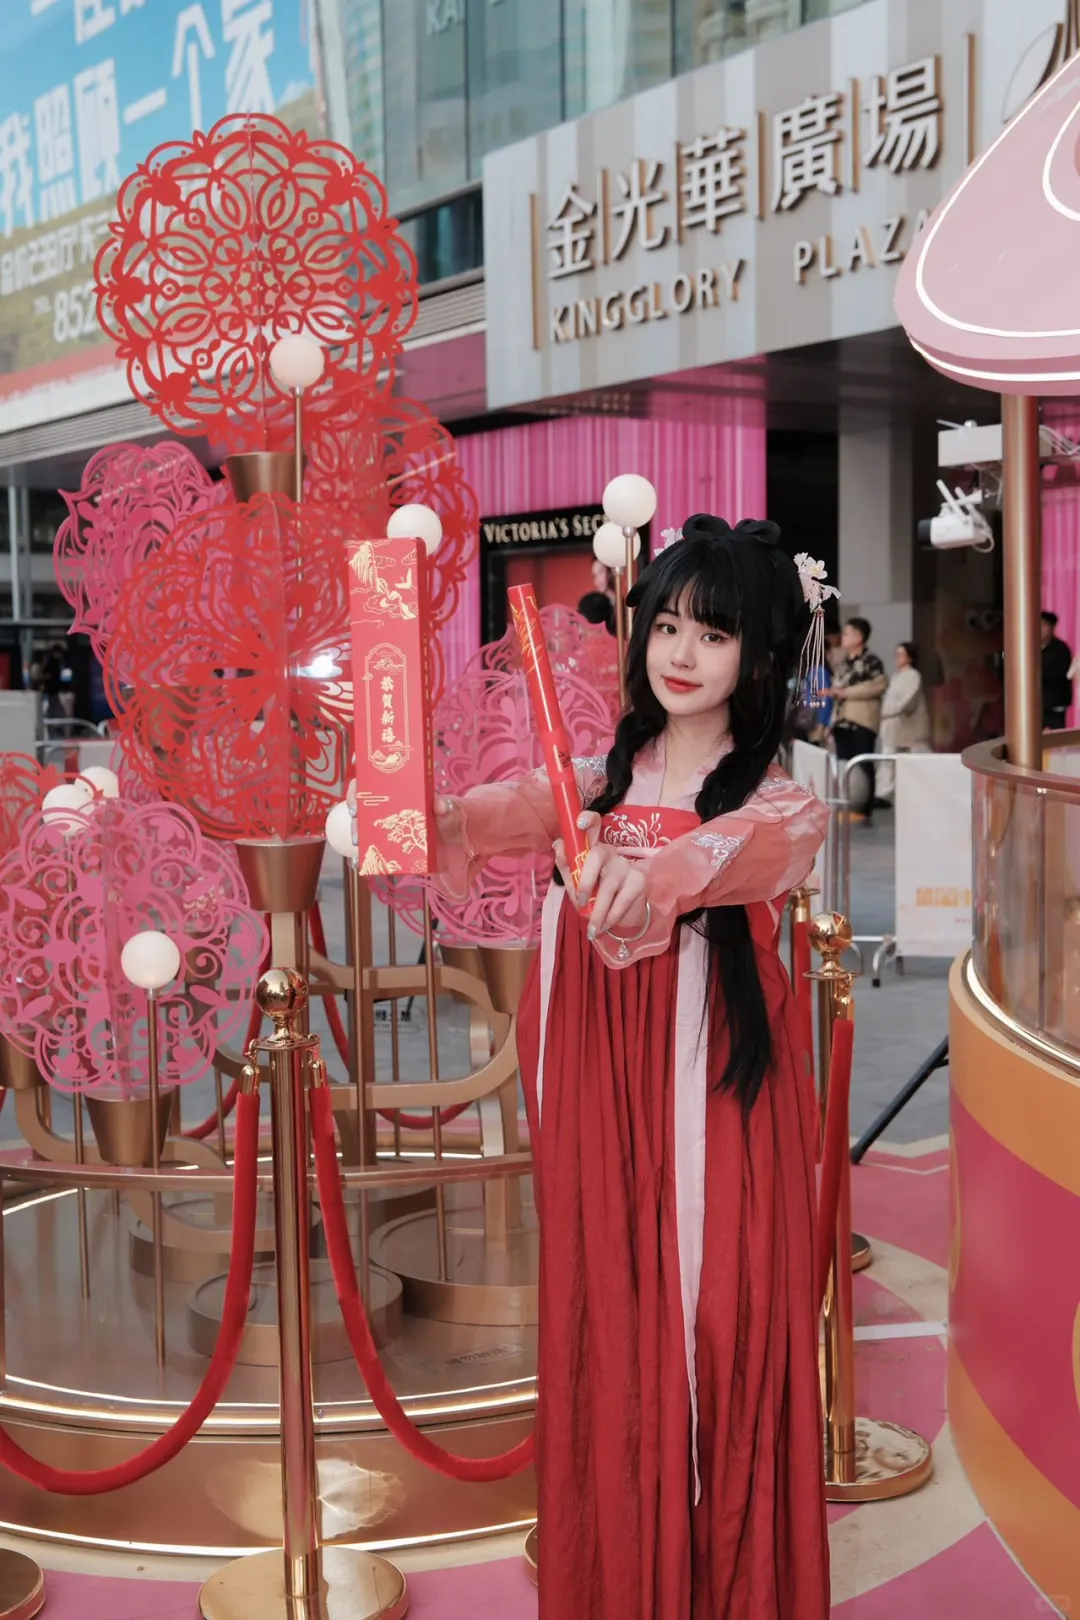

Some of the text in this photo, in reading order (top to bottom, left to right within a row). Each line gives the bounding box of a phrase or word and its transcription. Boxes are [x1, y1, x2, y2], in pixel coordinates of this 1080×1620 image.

[546, 55, 942, 281] 金光華廣場
[550, 259, 745, 343] KINGGLORY
[483, 517, 569, 543] VICTORIA'S
